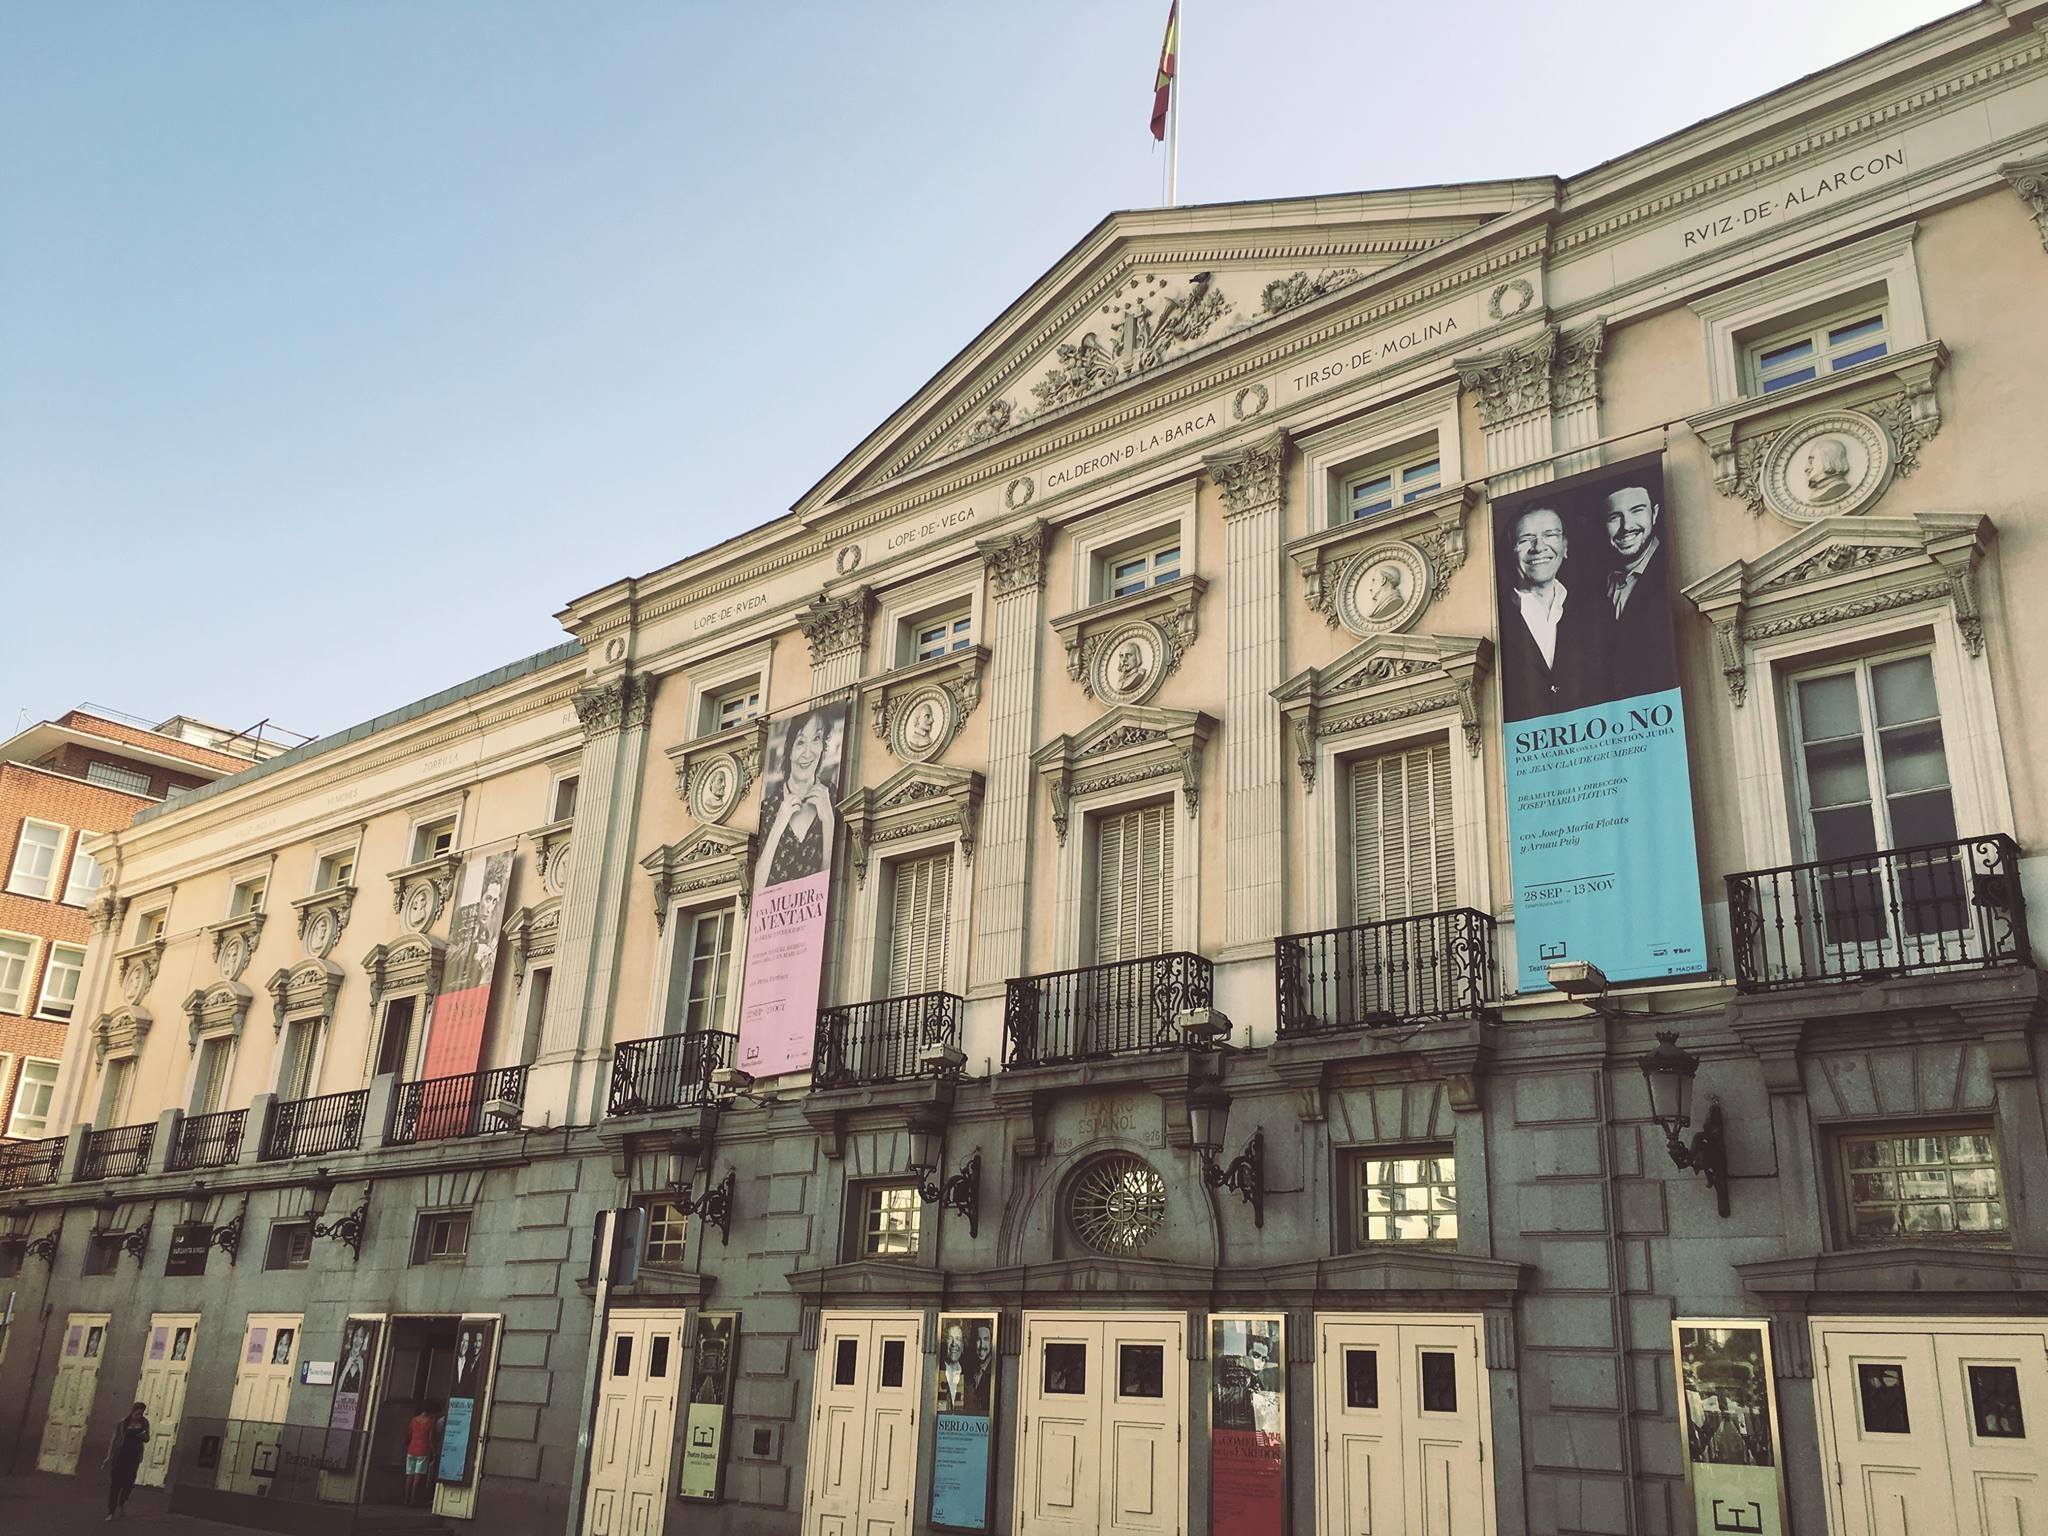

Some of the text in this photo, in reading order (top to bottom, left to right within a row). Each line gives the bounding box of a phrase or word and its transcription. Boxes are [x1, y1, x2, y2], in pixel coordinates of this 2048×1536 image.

[1683, 149, 1904, 247] RVIZ DE ALARCON
[1293, 317, 1458, 391] TIRSO DE MOLINA
[1047, 451, 1120, 487] CALDERON
[1165, 412, 1217, 443] BARCA
[888, 507, 975, 550] LOPE DE VEGA
[693, 594, 767, 631] LOPE DE RVEDA
[1515, 717, 1607, 754] SERLO
[1628, 704, 1673, 731] NO
[1515, 753, 1538, 764] PARA
[1540, 747, 1575, 760] ACABAR
[1516, 744, 1647, 777] DE JEAN CLAUDE GRUMBERG
[1517, 786, 1619, 812] JOSEP MARIA FLOTATS
[1539, 827, 1564, 839] Josep
[1566, 820, 1594, 834] Maria
[1596, 816, 1630, 829] Flotats
[1527, 841, 1558, 852] Arnau
[1559, 836, 1581, 847] Puig
[770, 888, 815, 914] MUJER
[1523, 890, 1538, 902] 28
[1539, 887, 1562, 900] SEP
[1573, 883, 1586, 895] 13
[1588, 878, 1615, 893] NOV
[762, 902, 822, 931] VENTANA
[1676, 964, 1703, 972] MADRID
[1078, 1114, 1136, 1135] ESPAÑOL
[938, 1420, 969, 1432] SERLO
[975, 1422, 989, 1433] NO
